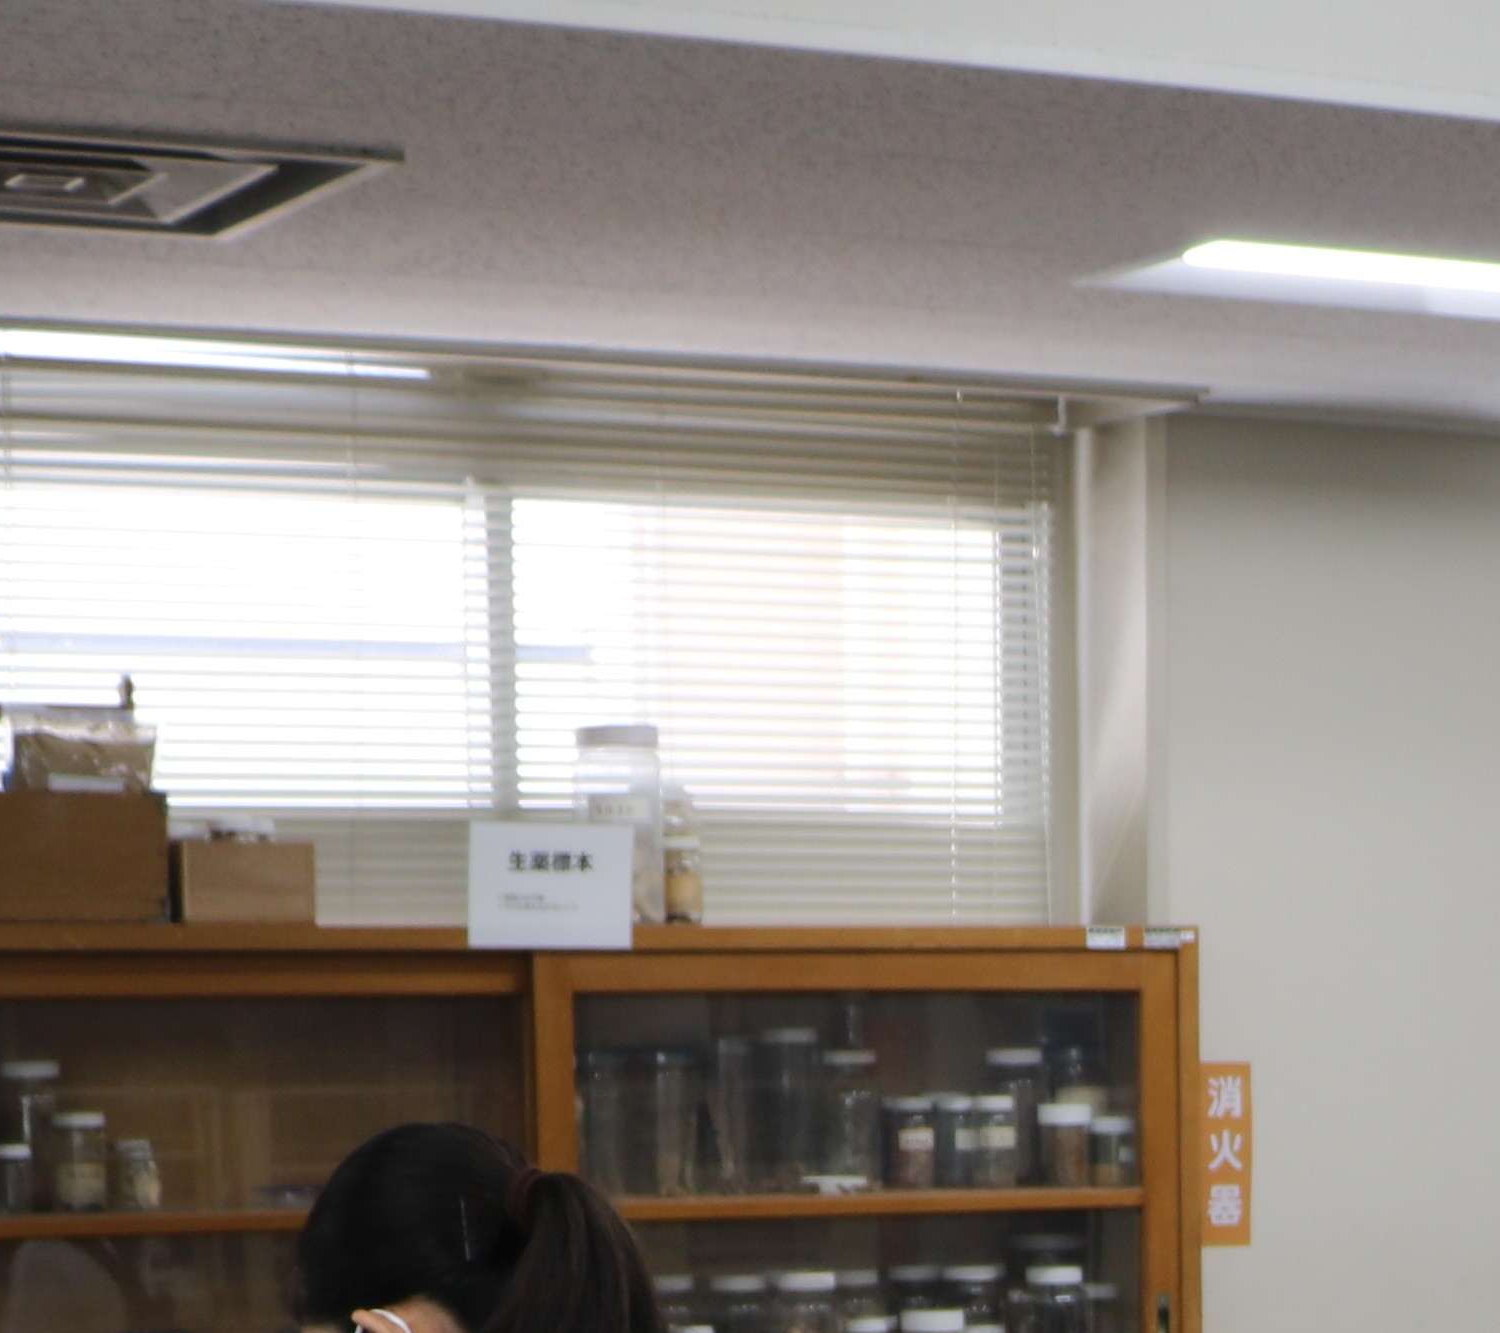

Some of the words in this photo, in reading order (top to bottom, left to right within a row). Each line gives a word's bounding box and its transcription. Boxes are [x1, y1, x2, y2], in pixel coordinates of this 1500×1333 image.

[508, 850, 594, 872] 生薬標本
[1207, 1075, 1243, 1227] 消火器
